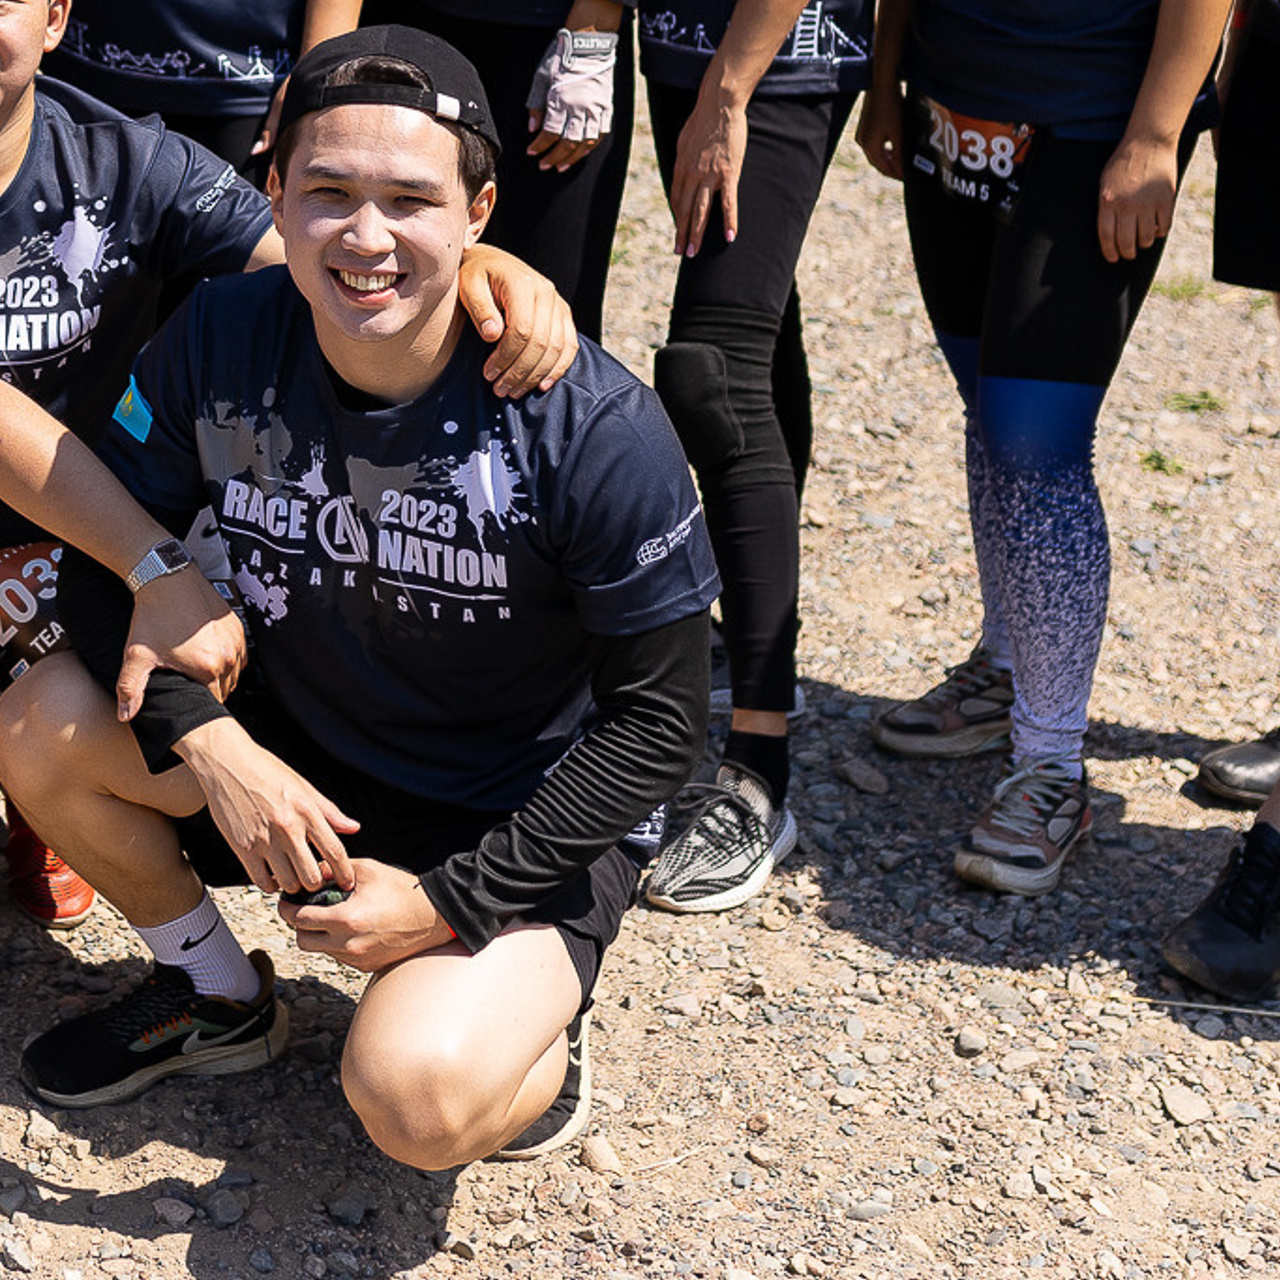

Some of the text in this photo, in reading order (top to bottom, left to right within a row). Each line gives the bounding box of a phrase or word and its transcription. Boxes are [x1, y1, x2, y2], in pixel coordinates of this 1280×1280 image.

[929, 108, 1016, 178] 2038
[979, 183, 990, 202] 5
[222, 479, 309, 540] RACE
[377, 529, 508, 589] NATION
[379, 489, 458, 539] 2023
[29, 621, 66, 654] TEA
